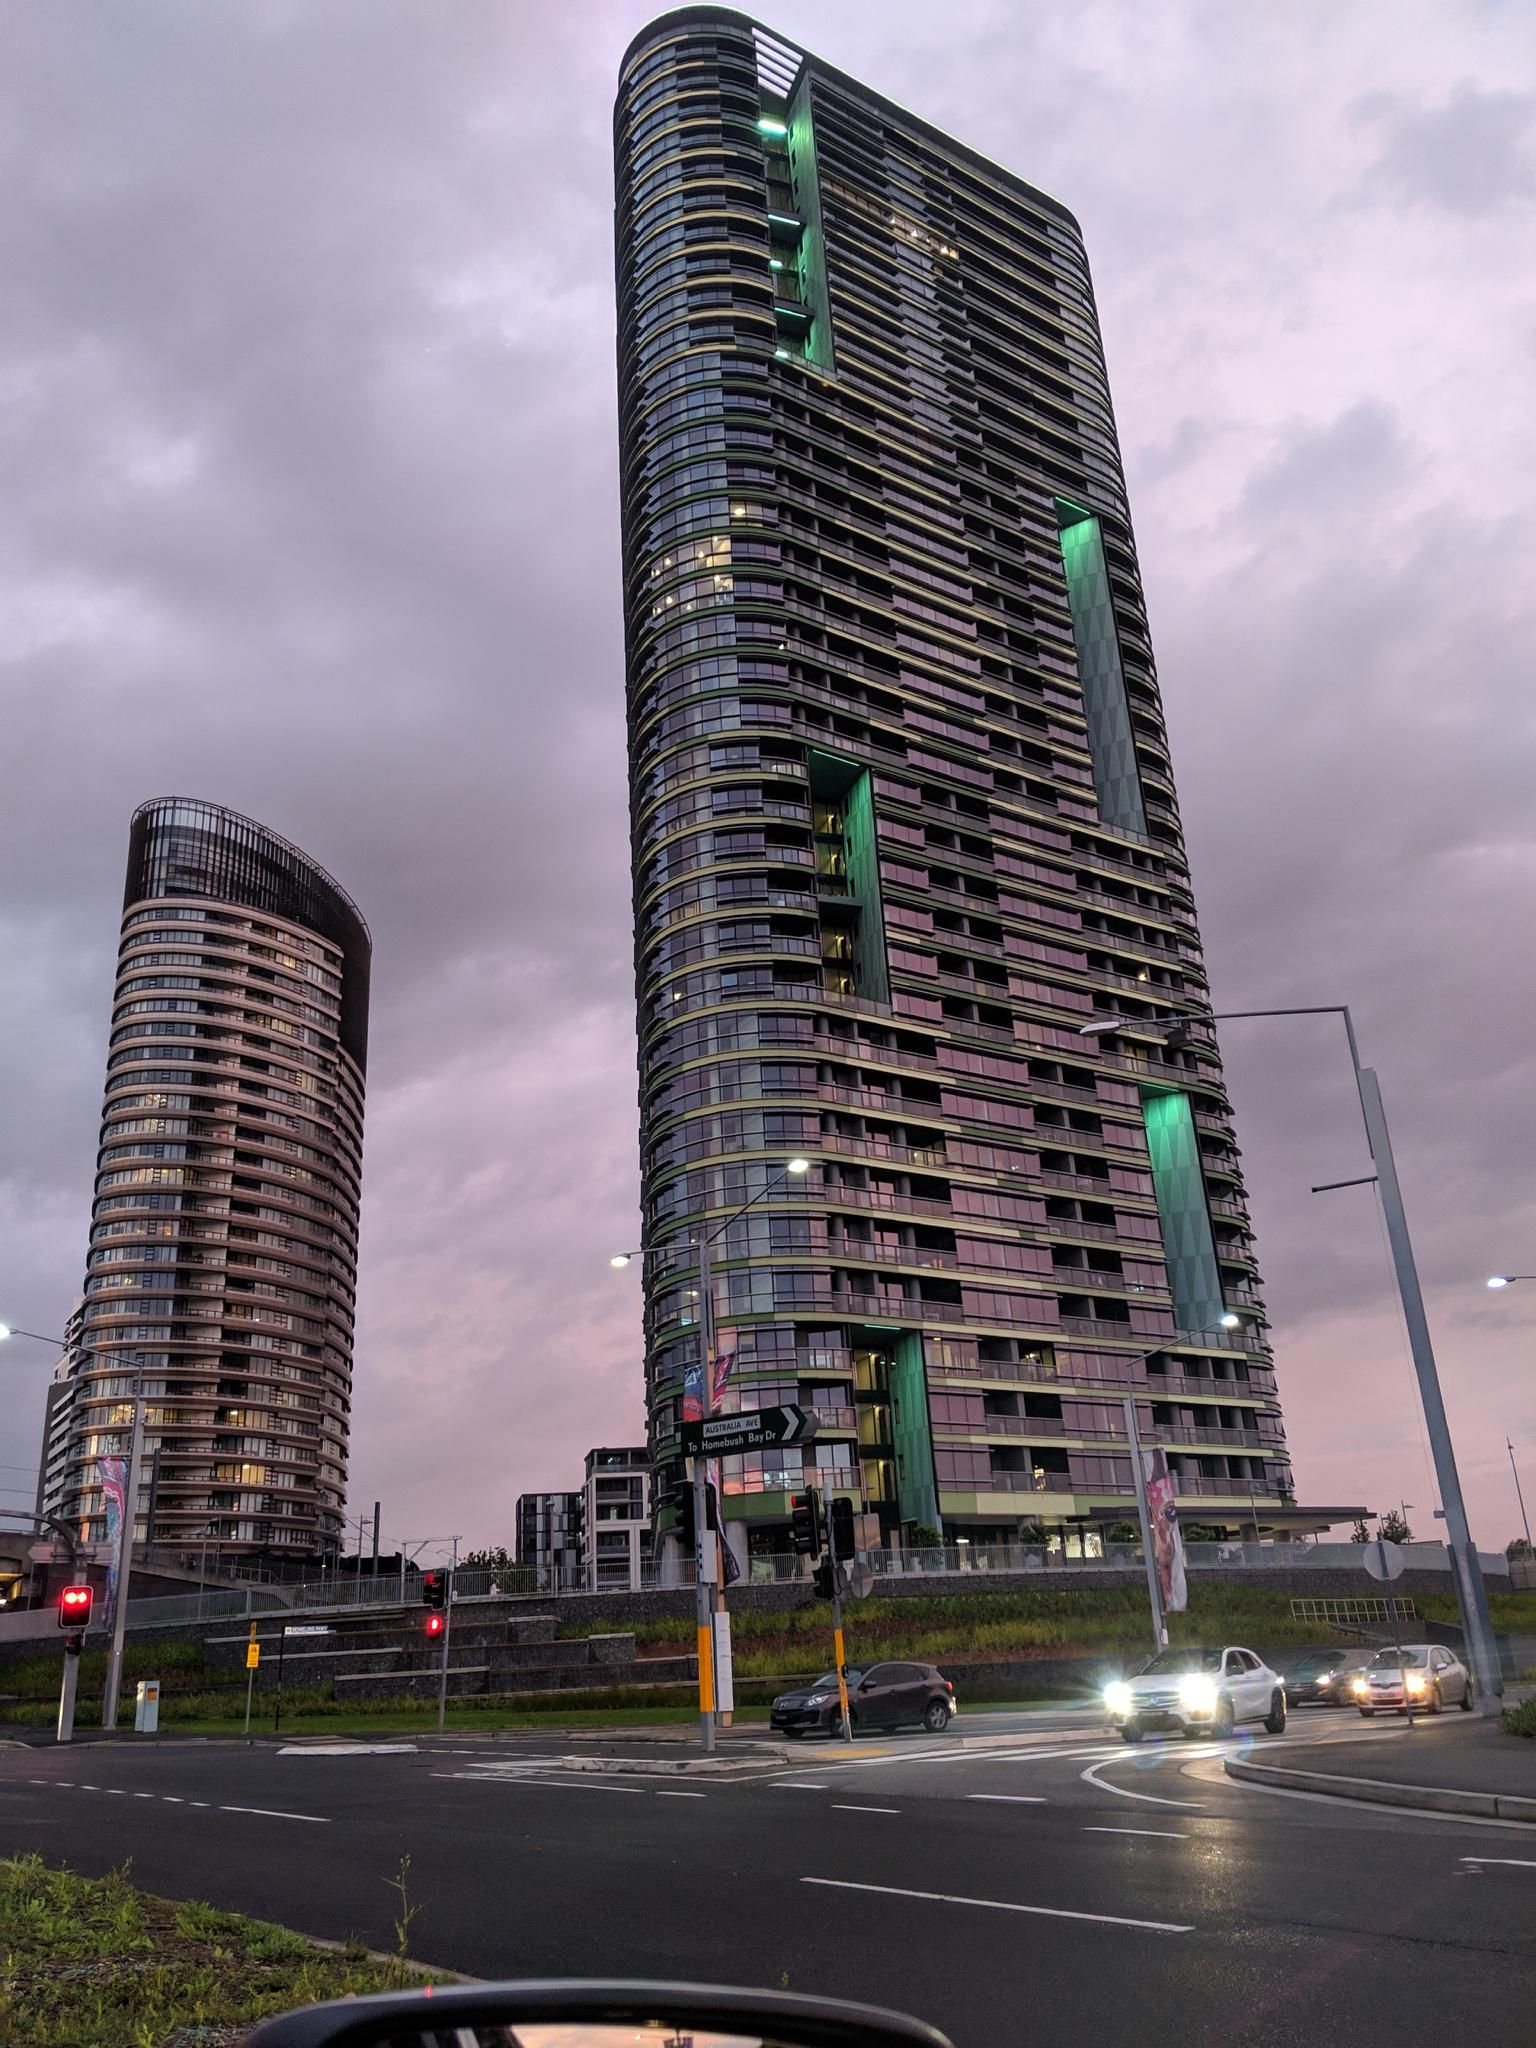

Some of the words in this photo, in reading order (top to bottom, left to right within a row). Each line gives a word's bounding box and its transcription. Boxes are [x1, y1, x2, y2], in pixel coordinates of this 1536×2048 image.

[705, 1421, 741, 1434] AUSTRALIA
[745, 1418, 758, 1427] AVE
[688, 1442, 697, 1453] To
[701, 1435, 744, 1451] Homebush
[748, 1432, 764, 1443] Bay
[765, 1430, 776, 1440] Dr
